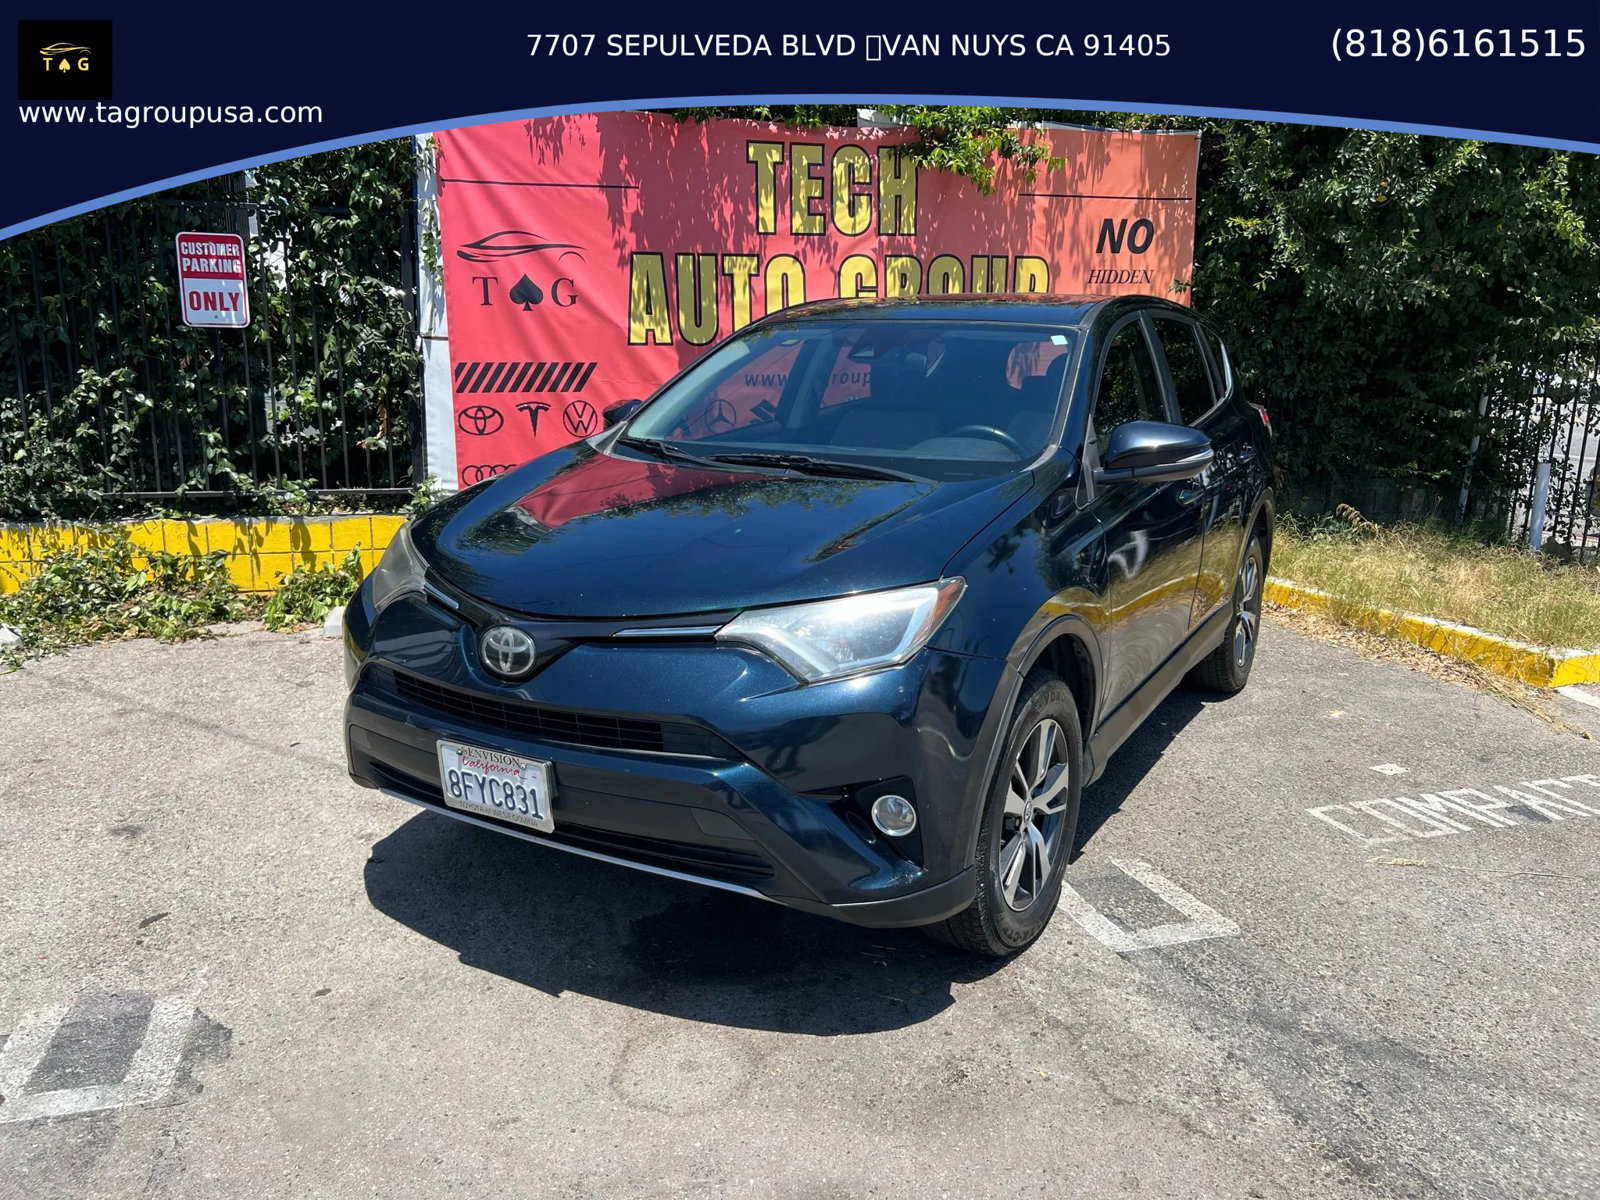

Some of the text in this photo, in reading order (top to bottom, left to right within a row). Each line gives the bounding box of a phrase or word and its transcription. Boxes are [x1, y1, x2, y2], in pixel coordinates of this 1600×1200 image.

[746, 139, 918, 237] TECH
[1095, 218, 1155, 254] NO
[180, 241, 240, 257] CUSTOMER
[182, 257, 242, 274] PARKING
[1087, 269, 1155, 285] HIDDEN
[188, 290, 240, 312] ONLY
[472, 276, 578, 308] T G
[461, 756, 522, 776] California
[468, 746, 521, 769] ENVISION
[448, 768, 544, 821] 8FYC831
